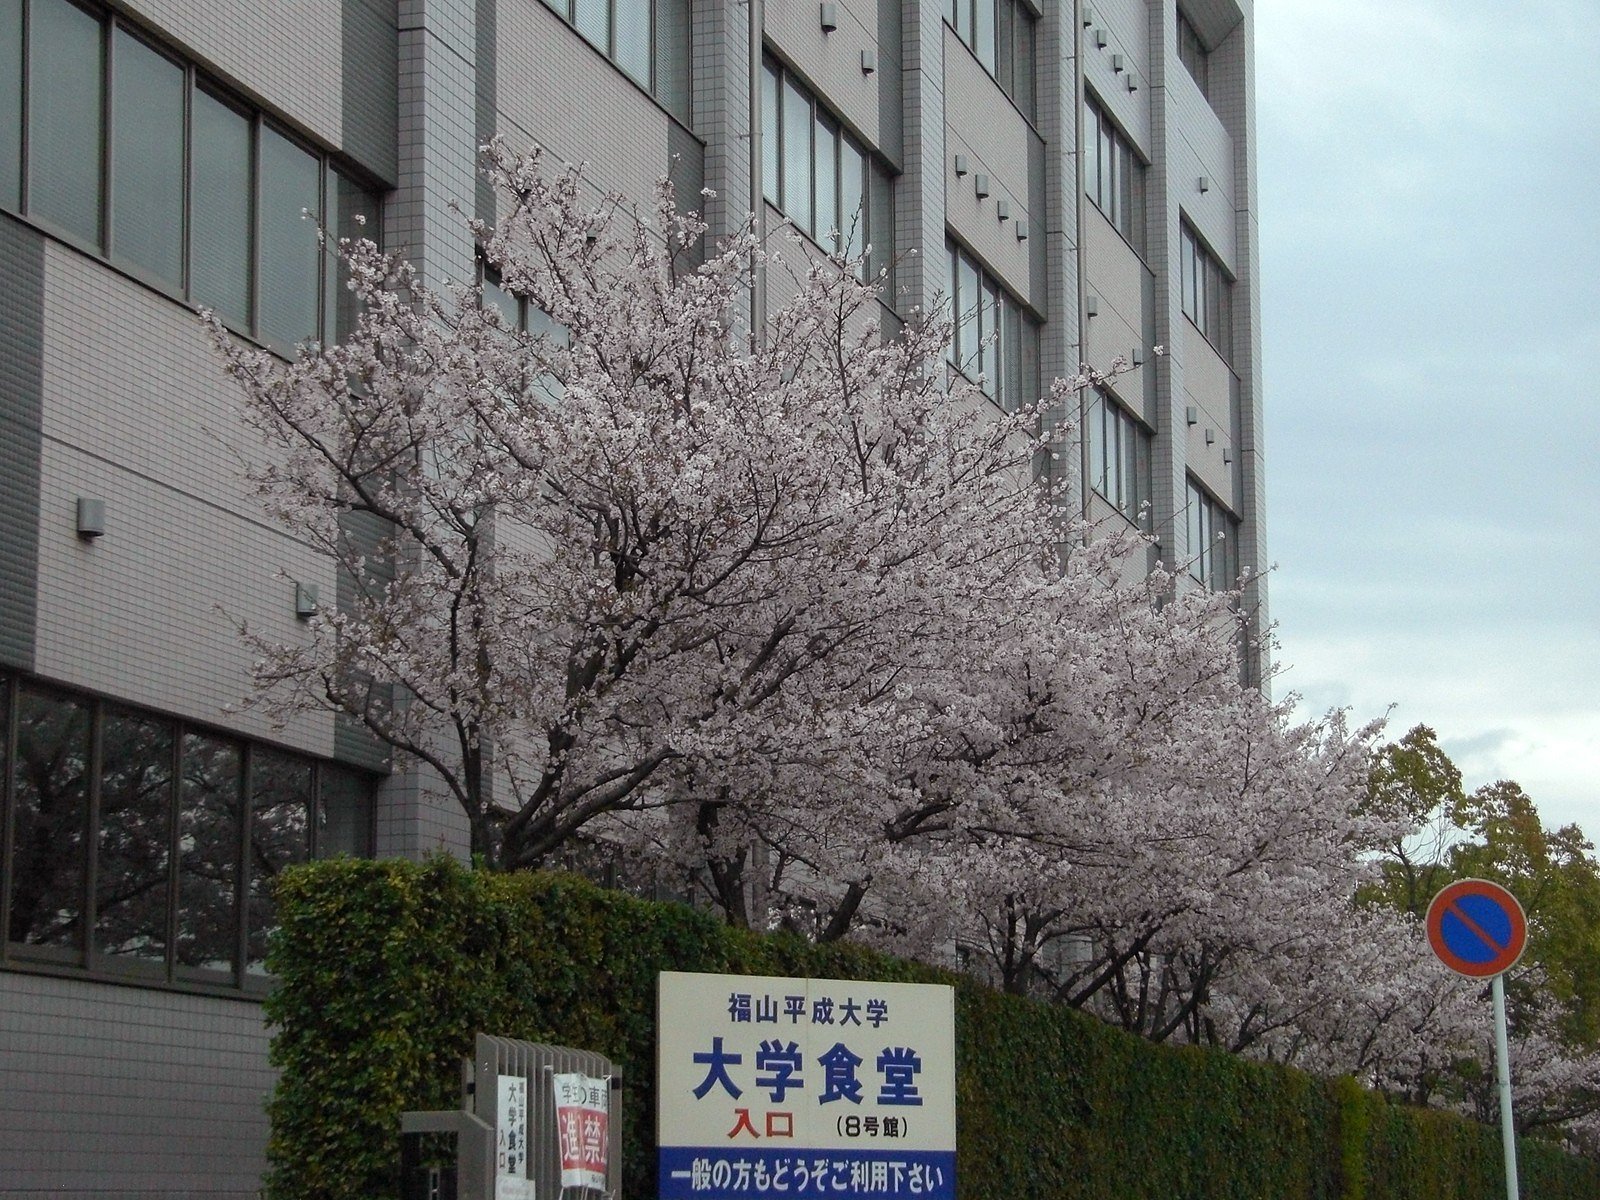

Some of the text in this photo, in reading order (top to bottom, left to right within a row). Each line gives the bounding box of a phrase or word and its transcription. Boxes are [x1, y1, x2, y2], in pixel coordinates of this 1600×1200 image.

[728, 992, 889, 1028] 福山平成大学
[692, 1036, 923, 1106] 大学食堂
[508, 1083, 517, 1173] 大学食堂
[727, 1108, 794, 1139] 入口
[499, 1130, 506, 1168] 入口
[671, 1157, 943, 1193] 一般の方もどうぞご利用下さい
